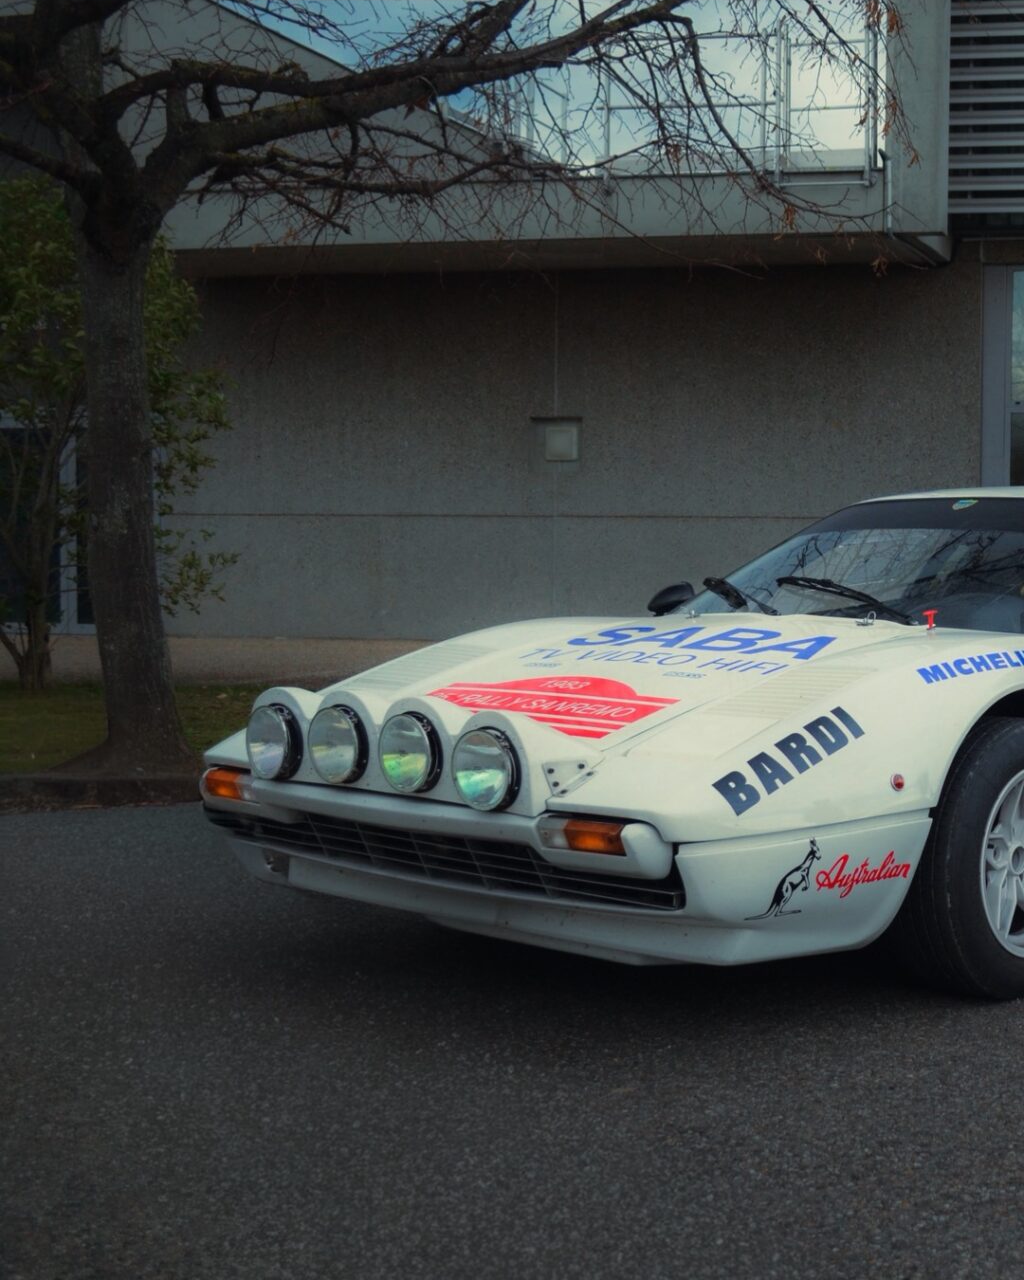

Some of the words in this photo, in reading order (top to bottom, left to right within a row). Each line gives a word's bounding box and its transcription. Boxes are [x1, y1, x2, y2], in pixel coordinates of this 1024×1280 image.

[567, 625, 838, 660] SABA
[518, 647, 581, 660] TV
[575, 649, 698, 667] VIDEO
[696, 656, 791, 676] HIFI
[539, 679, 592, 691] 1983
[461, 693, 525, 710] RALLY
[521, 698, 637, 719] SANREMO
[711, 706, 866, 818] BARDI
[815, 851, 911, 899] Australian
